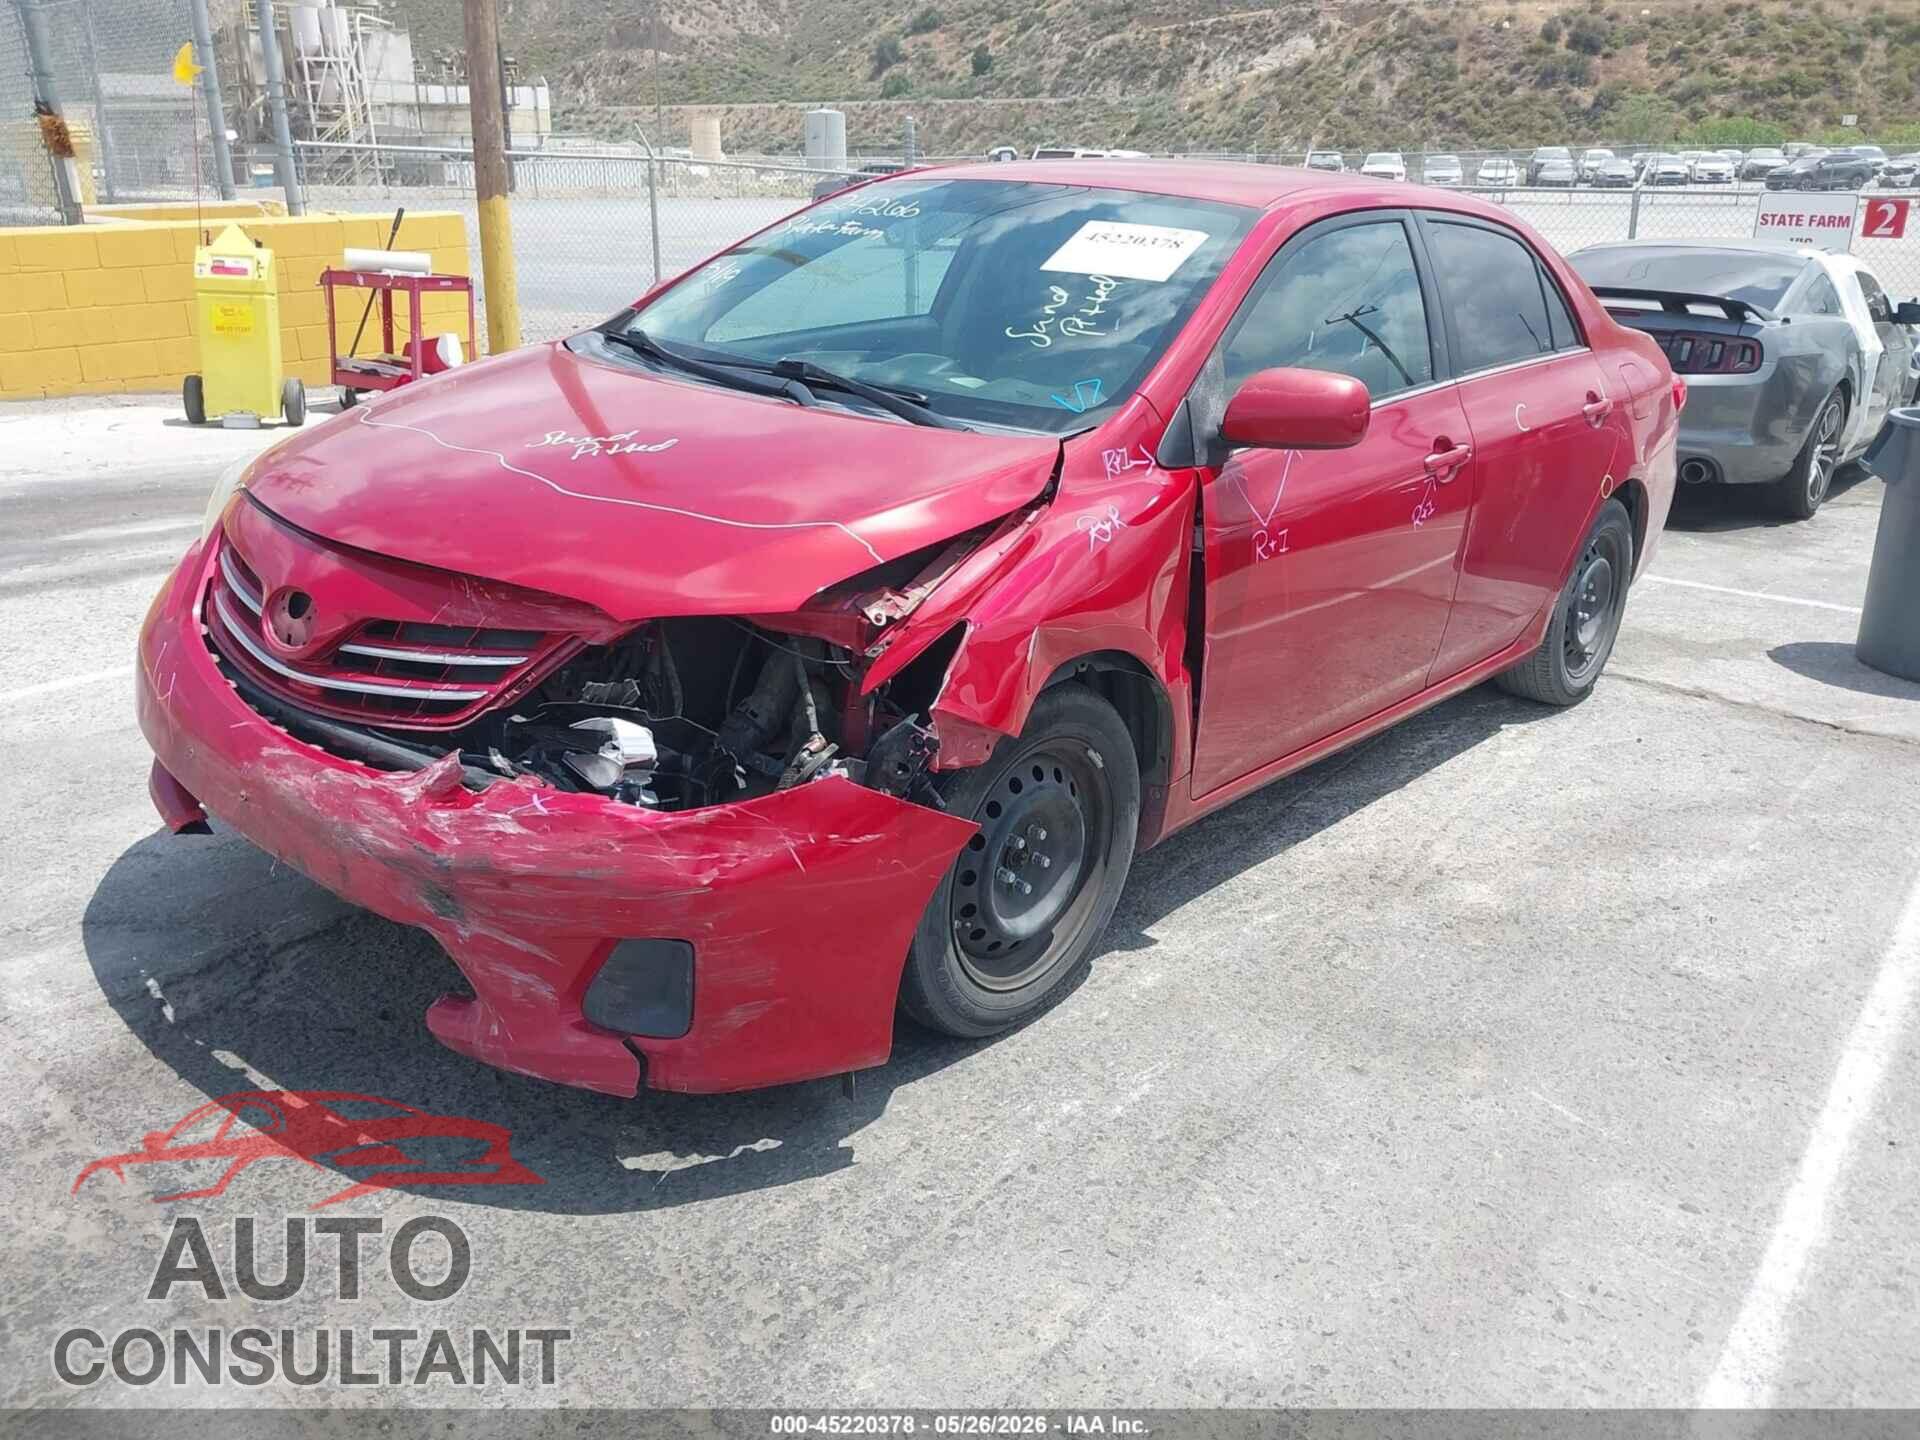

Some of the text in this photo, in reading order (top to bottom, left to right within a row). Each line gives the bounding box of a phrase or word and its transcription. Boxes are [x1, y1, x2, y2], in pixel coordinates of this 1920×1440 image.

[1759, 213, 1851, 229] STATE FARM
[1871, 202, 1898, 236] 2
[1084, 232, 1184, 249] 45220378
